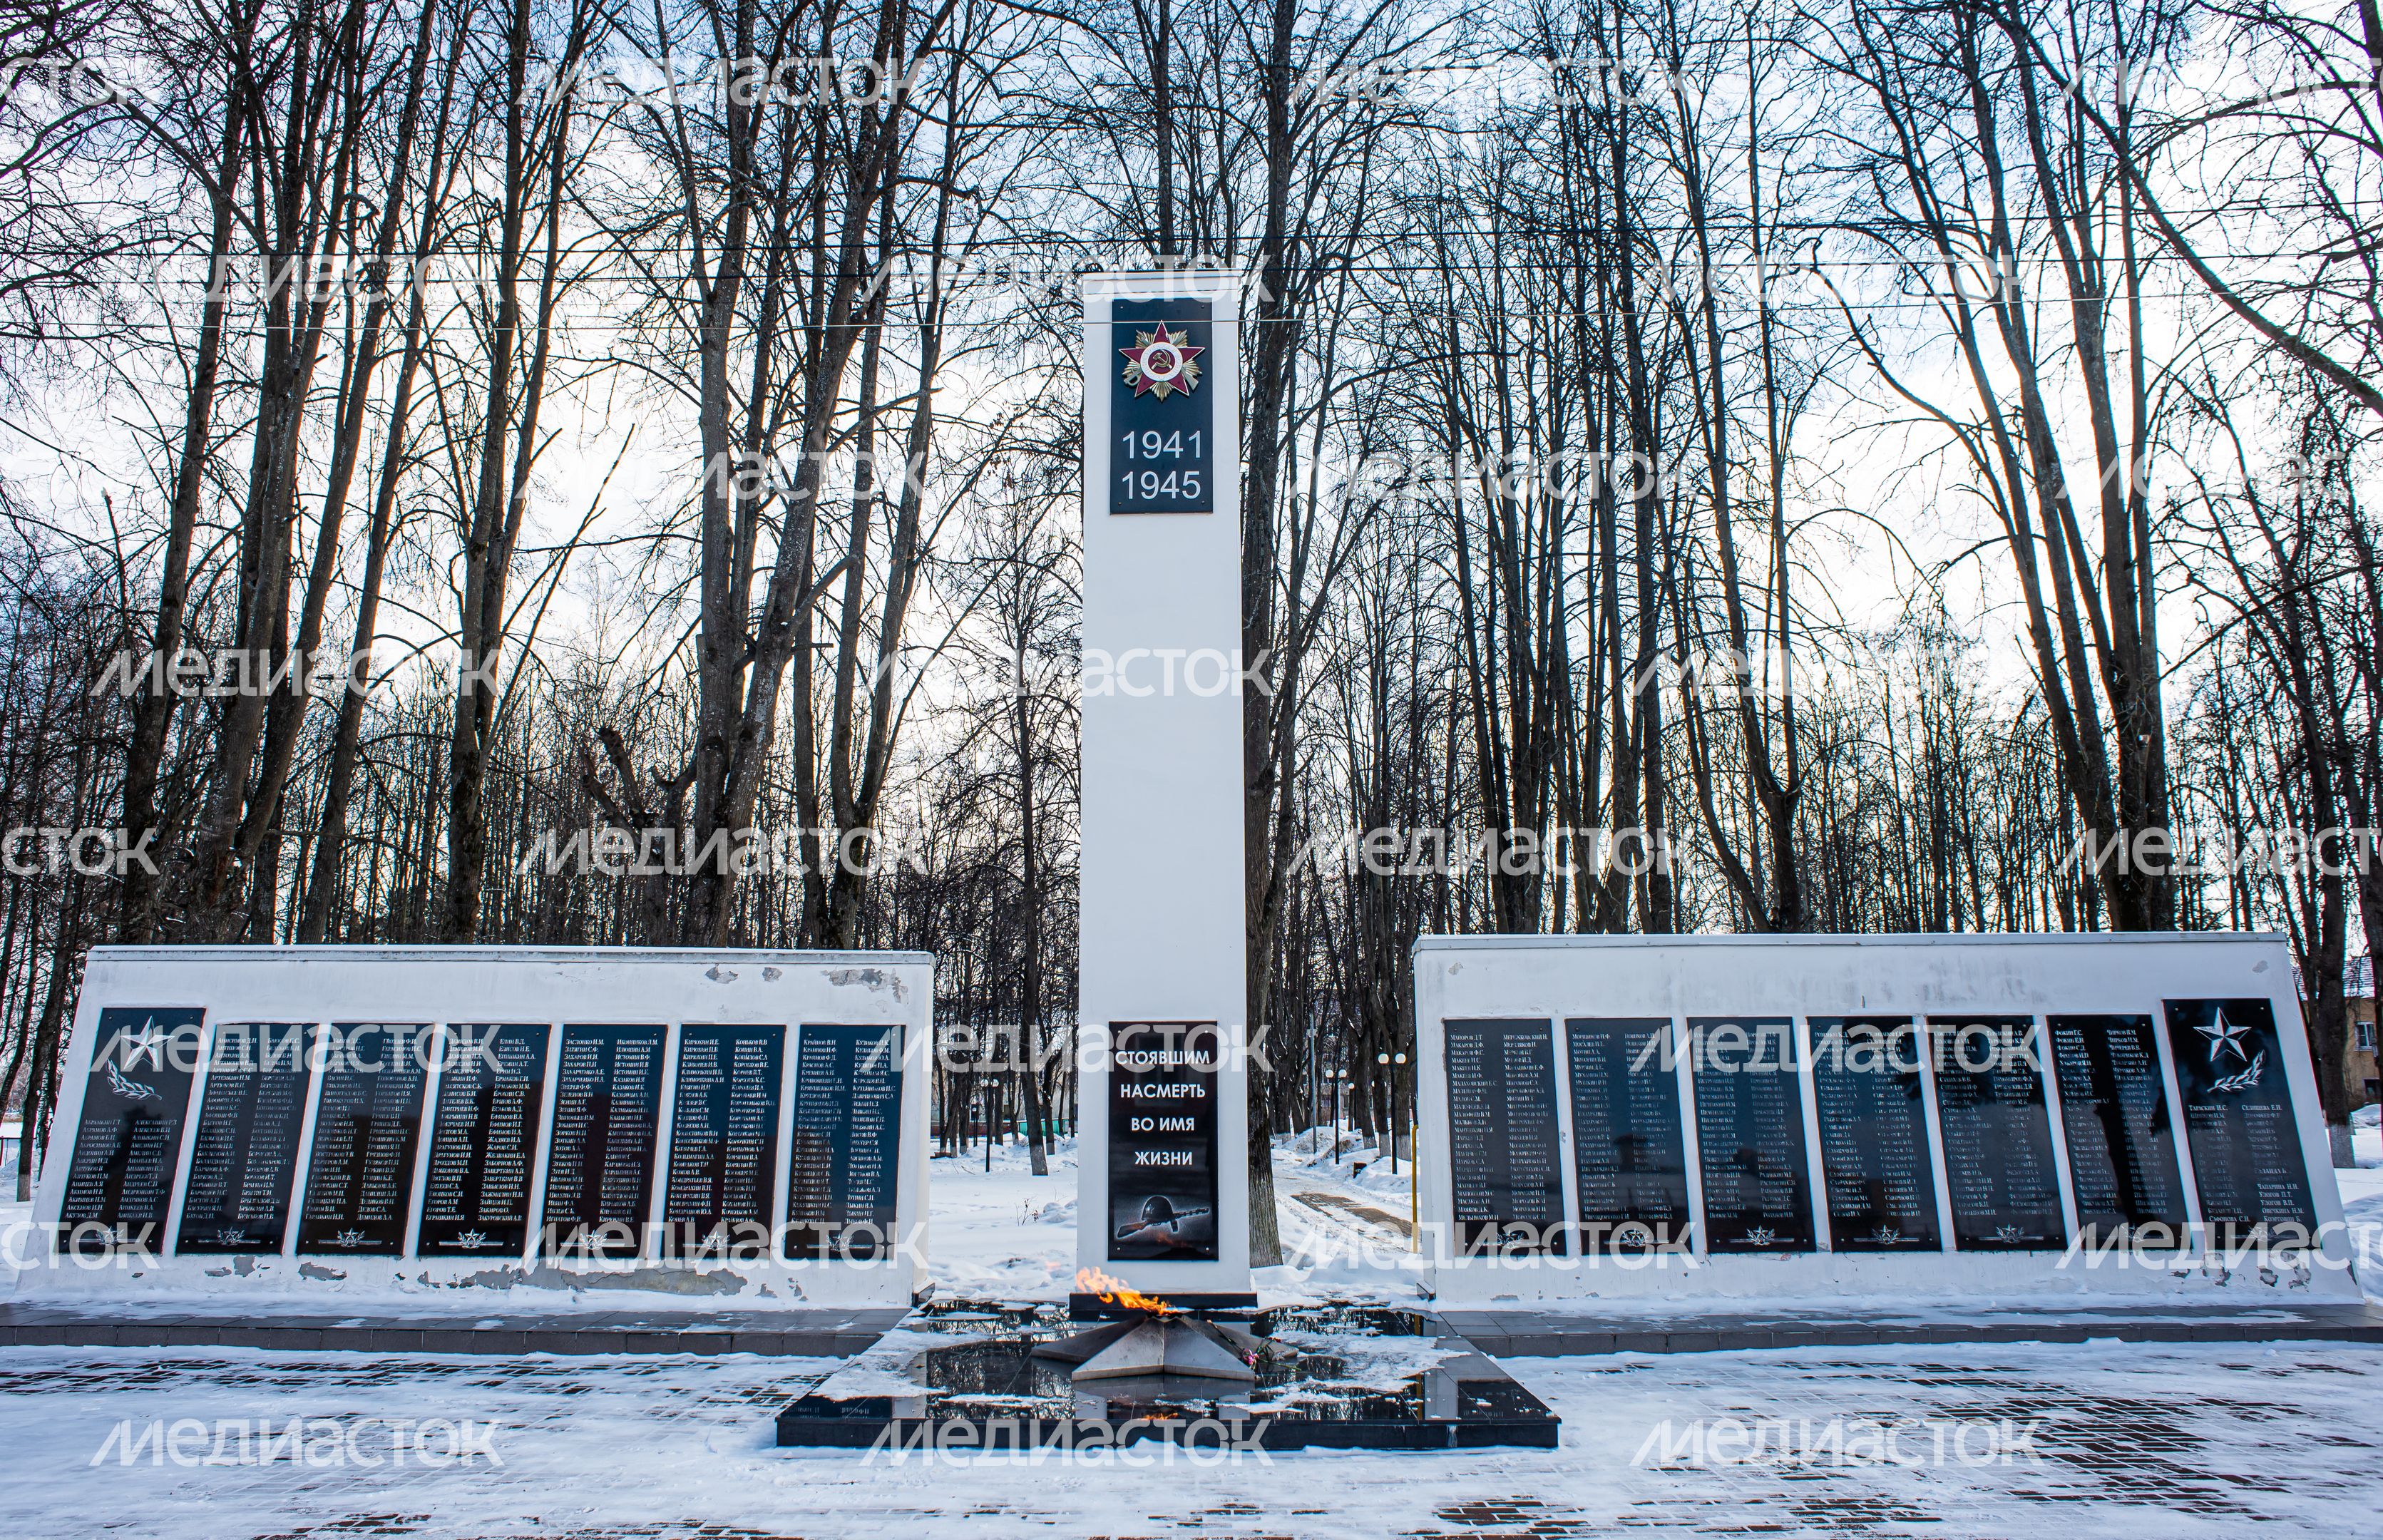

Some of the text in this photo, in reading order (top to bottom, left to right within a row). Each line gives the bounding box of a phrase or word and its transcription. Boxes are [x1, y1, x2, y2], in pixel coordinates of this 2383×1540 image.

[1122, 430, 1201, 459] 1941
[1121, 471, 1201, 500] 1945
[1115, 1050, 1210, 1065] СТОЯВШИМ
[1120, 1084, 1206, 1098] НАСМЕРТЬ
[1131, 1117, 1194, 1132] ВО ИМЯ
[1135, 1151, 1192, 1166] ЖИЗНИ
